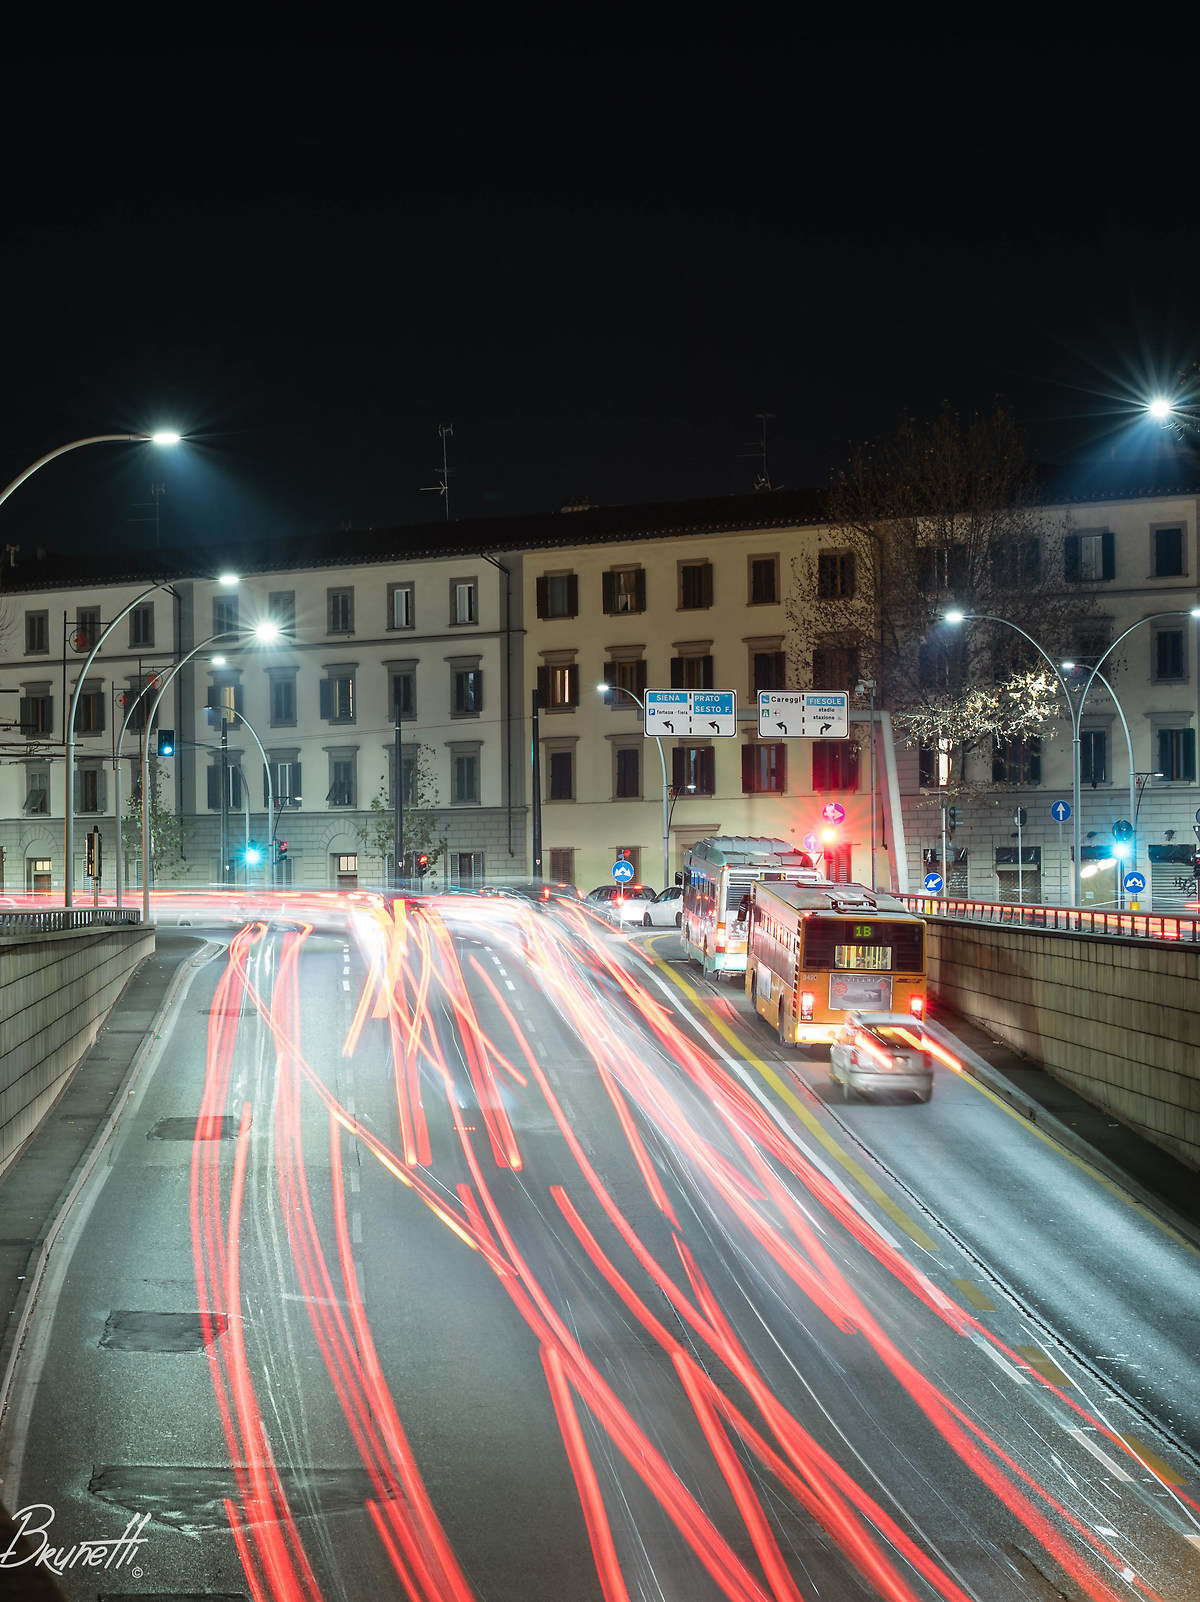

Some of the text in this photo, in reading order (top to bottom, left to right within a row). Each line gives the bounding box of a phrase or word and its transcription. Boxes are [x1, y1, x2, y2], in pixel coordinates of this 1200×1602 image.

[656, 694, 680, 702] SIENA
[771, 695, 801, 704] Careggi
[856, 926, 871, 937] 1B
